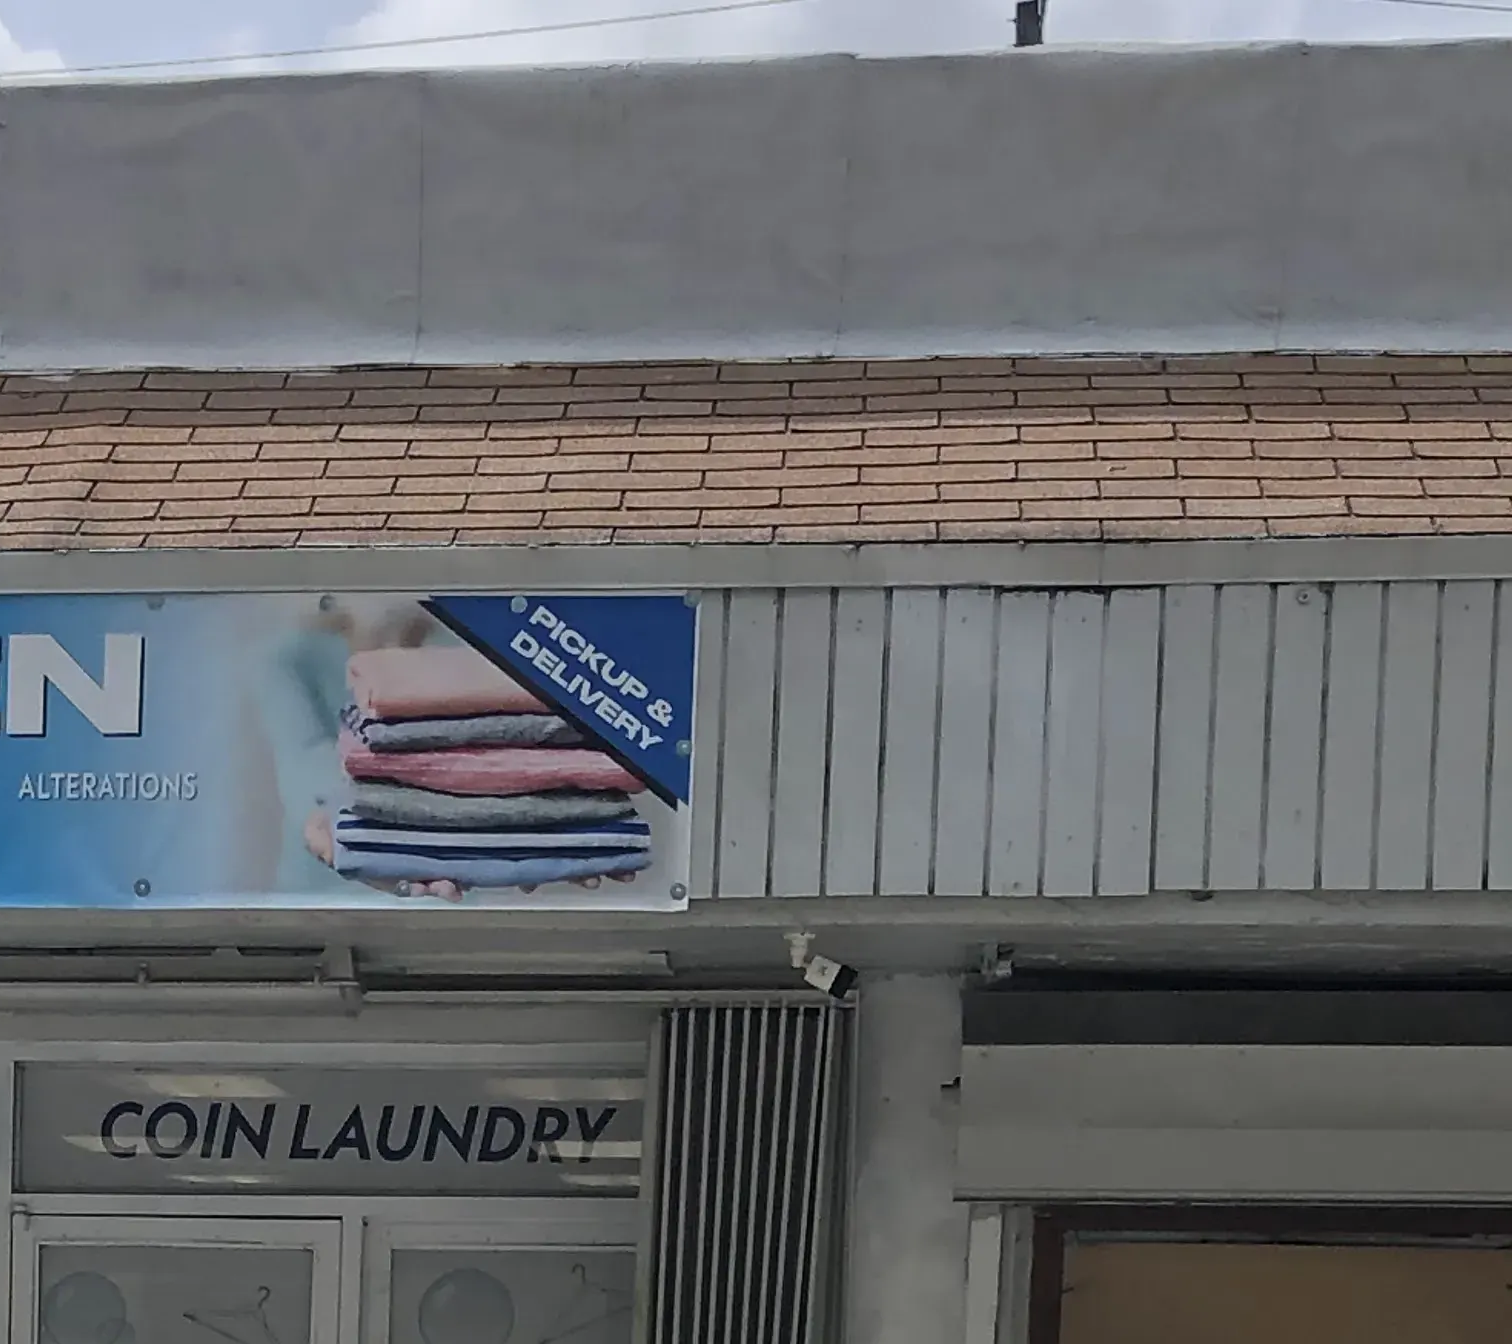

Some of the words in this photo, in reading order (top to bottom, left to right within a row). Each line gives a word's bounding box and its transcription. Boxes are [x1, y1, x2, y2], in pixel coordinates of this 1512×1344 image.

[509, 629, 664, 751] DELIVERY
[528, 605, 649, 701] PICKUP
[645, 698, 674, 729] &
[18, 772, 198, 801] ALTERATIONS
[100, 1101, 276, 1160] COIN
[288, 1103, 617, 1164] LAUNDRY
